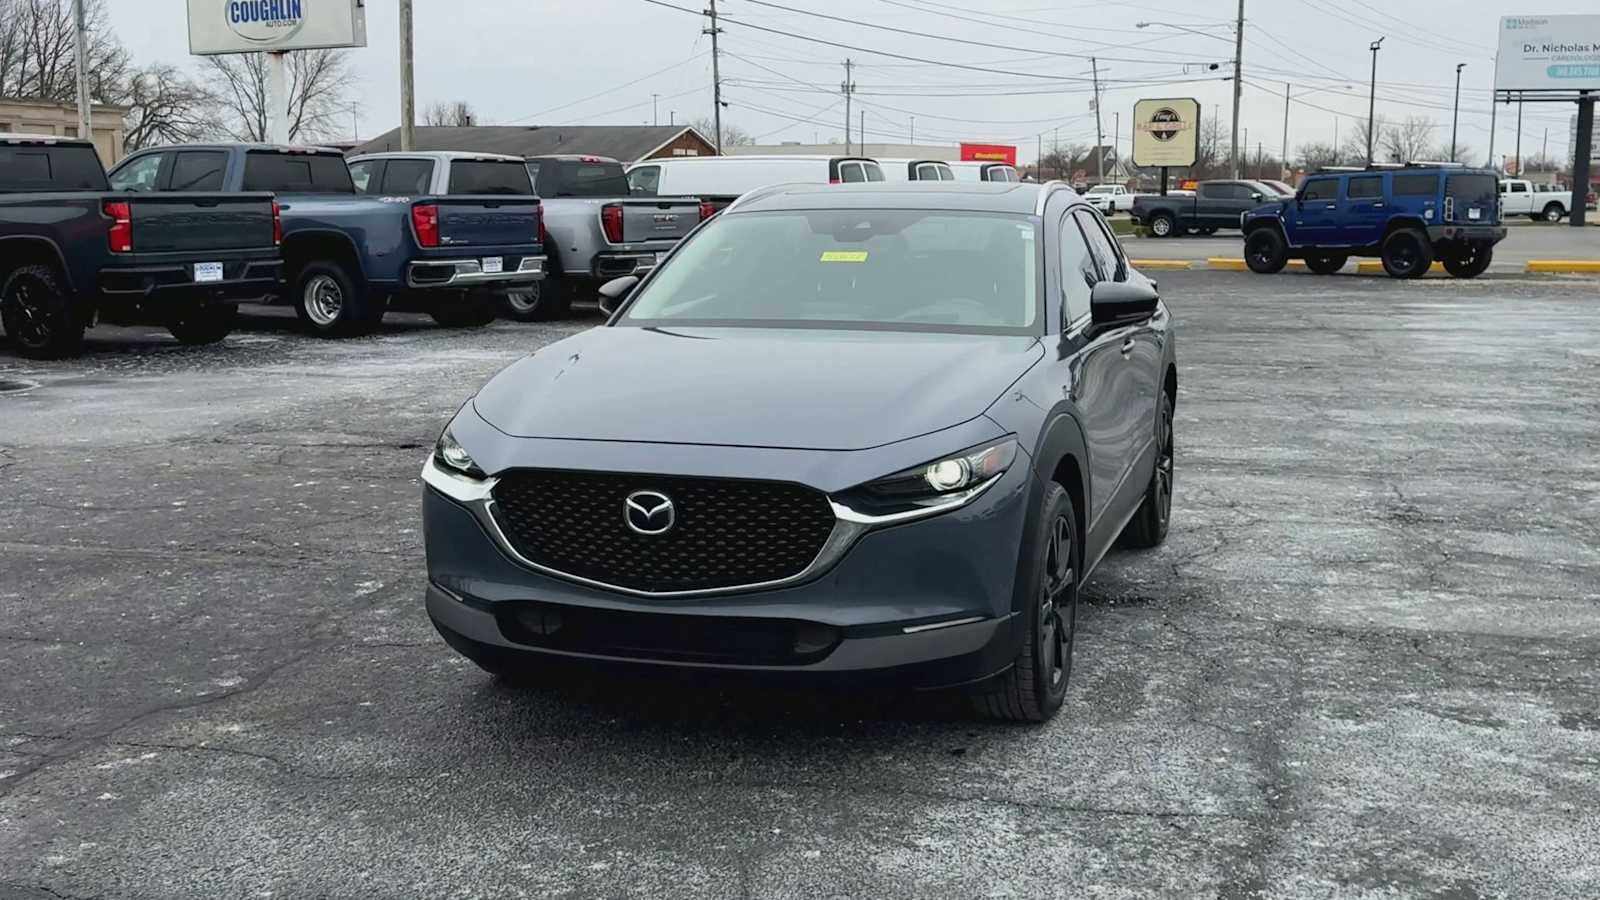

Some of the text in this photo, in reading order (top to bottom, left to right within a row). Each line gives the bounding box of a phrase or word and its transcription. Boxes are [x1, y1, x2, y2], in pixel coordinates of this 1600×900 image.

[231, 0, 302, 23] COUGHLIN
[1523, 44, 1539, 53] Dr.
[1542, 43, 1590, 53] Nicholas
